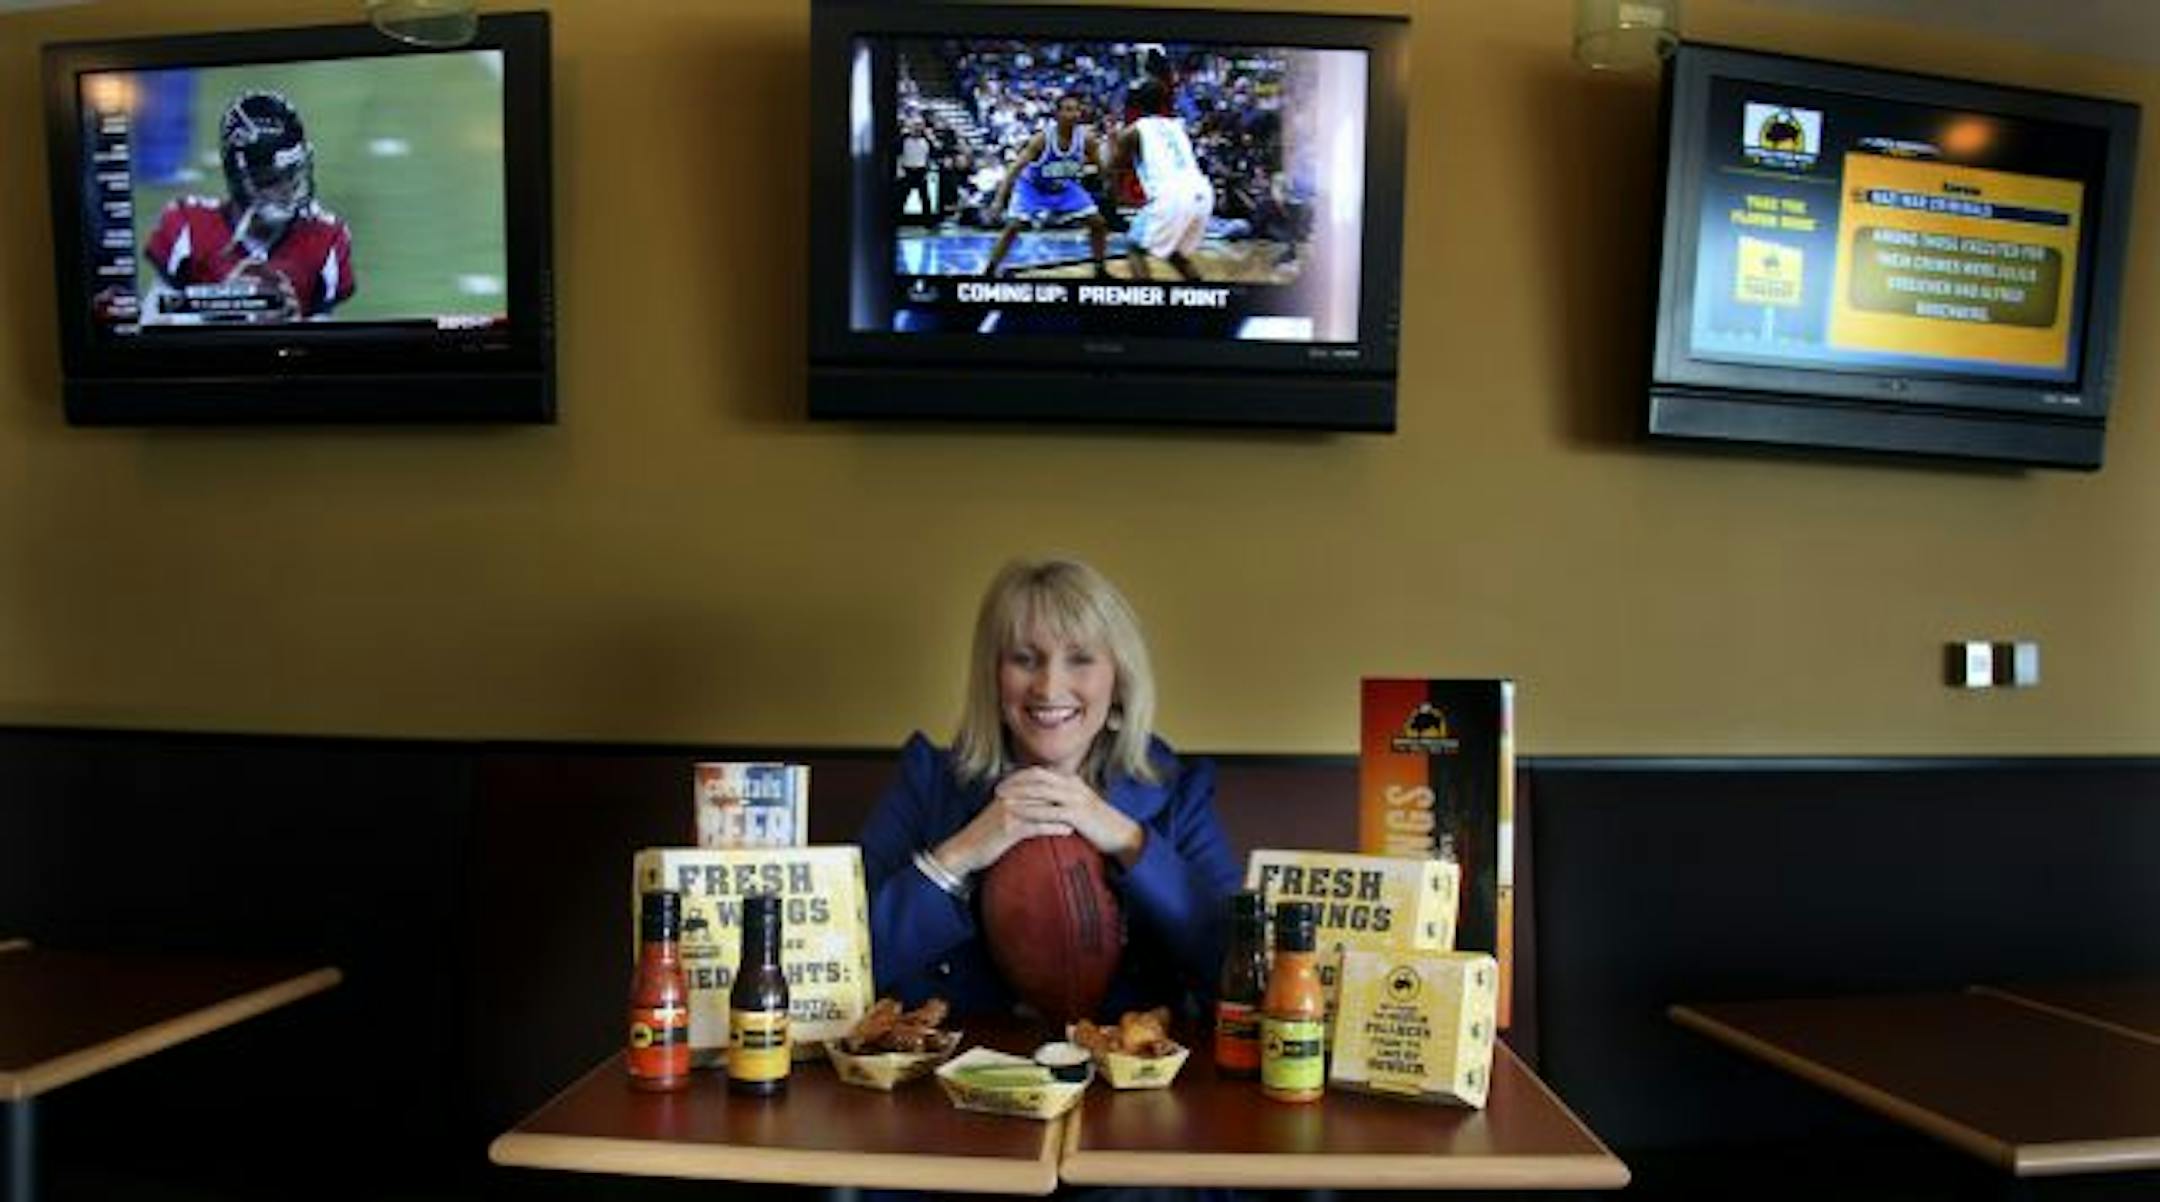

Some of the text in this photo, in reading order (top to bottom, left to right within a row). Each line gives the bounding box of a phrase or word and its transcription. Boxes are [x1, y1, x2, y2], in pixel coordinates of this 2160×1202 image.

[957, 282, 1033, 303] COMING
[1035, 284, 1068, 302] UP:
[1078, 285, 1164, 306] PREMIER
[1169, 288, 1230, 307] POINT
[678, 865, 813, 896] FRESH
[1261, 866, 1384, 900] FRESH
[716, 900, 830, 929] WGS
